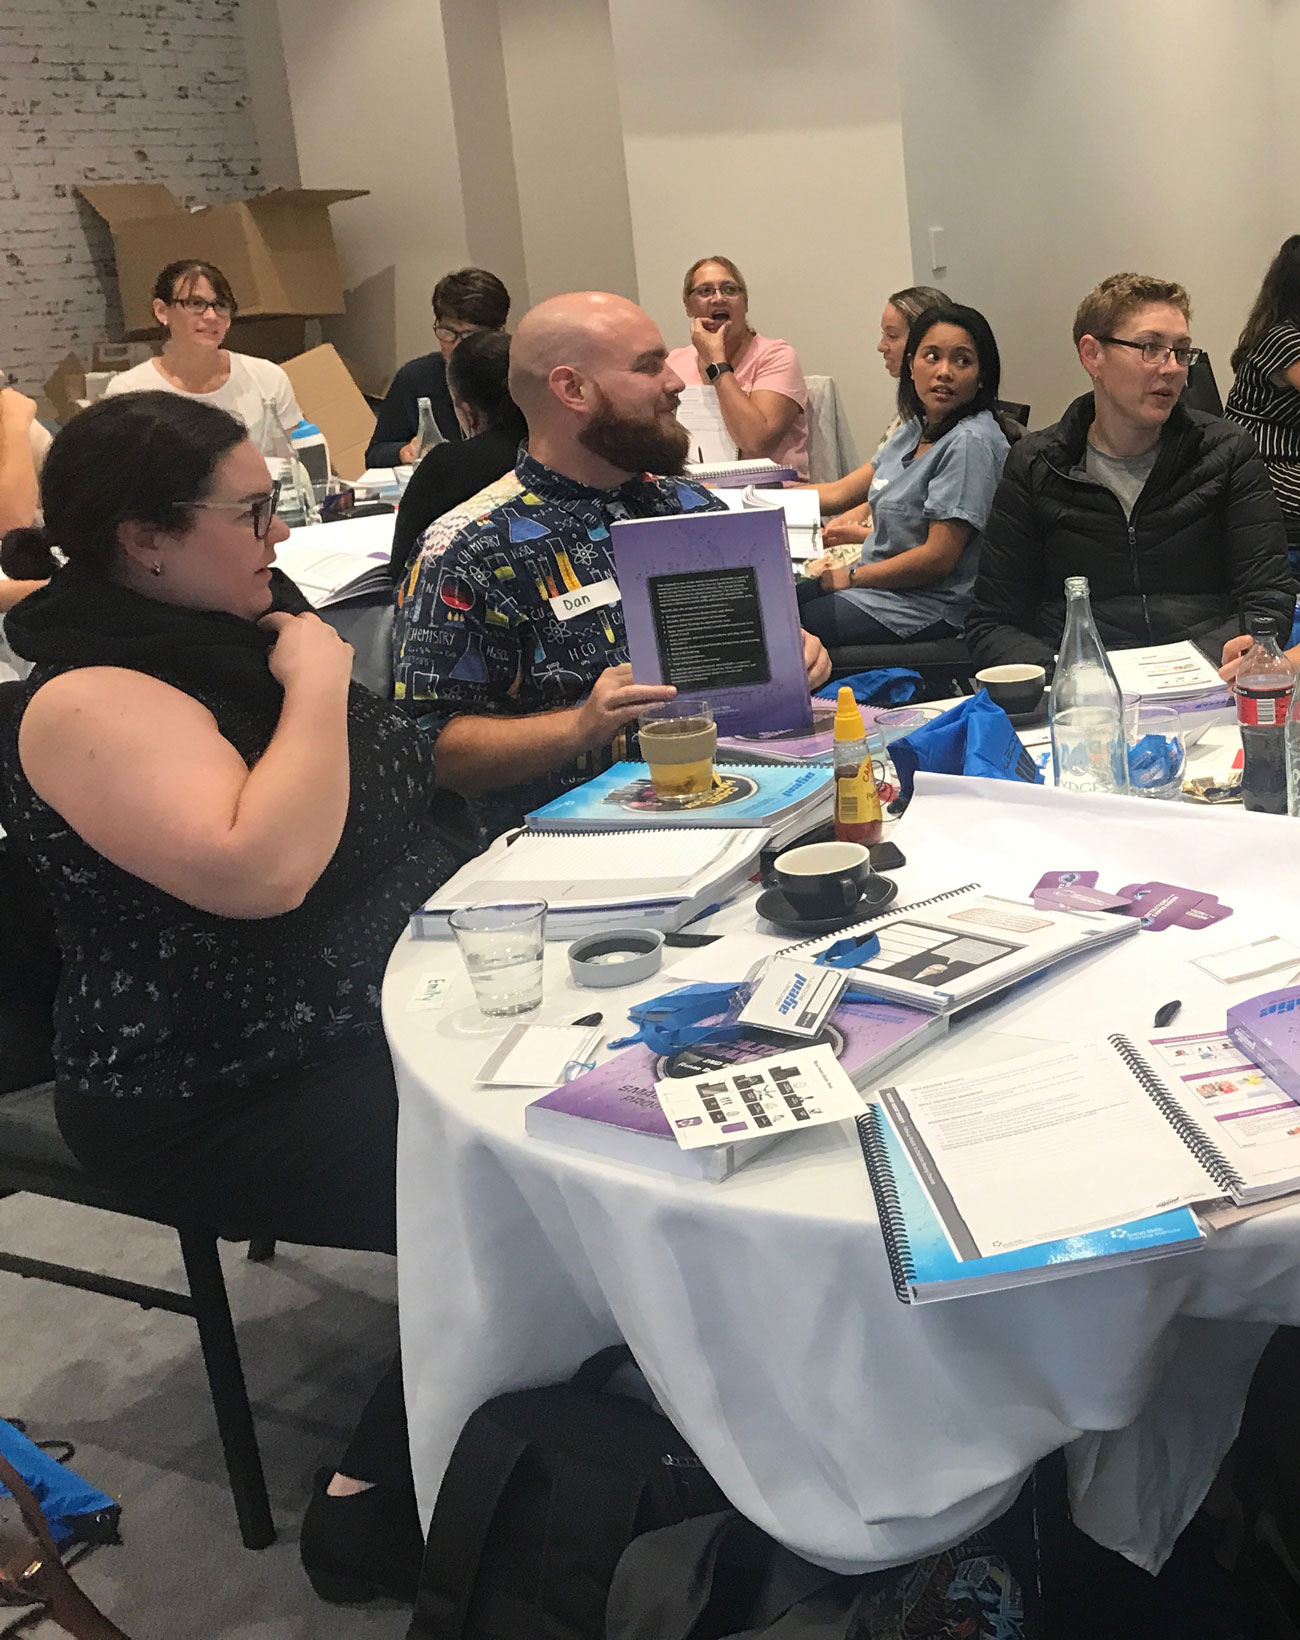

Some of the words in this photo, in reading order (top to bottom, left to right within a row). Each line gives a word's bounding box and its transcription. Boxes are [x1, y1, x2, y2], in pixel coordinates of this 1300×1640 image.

[562, 594, 591, 612] Dan
[408, 627, 455, 646] CHEMISTRY
[778, 973, 807, 1015] agent
[618, 1083, 658, 1100] SMAL
